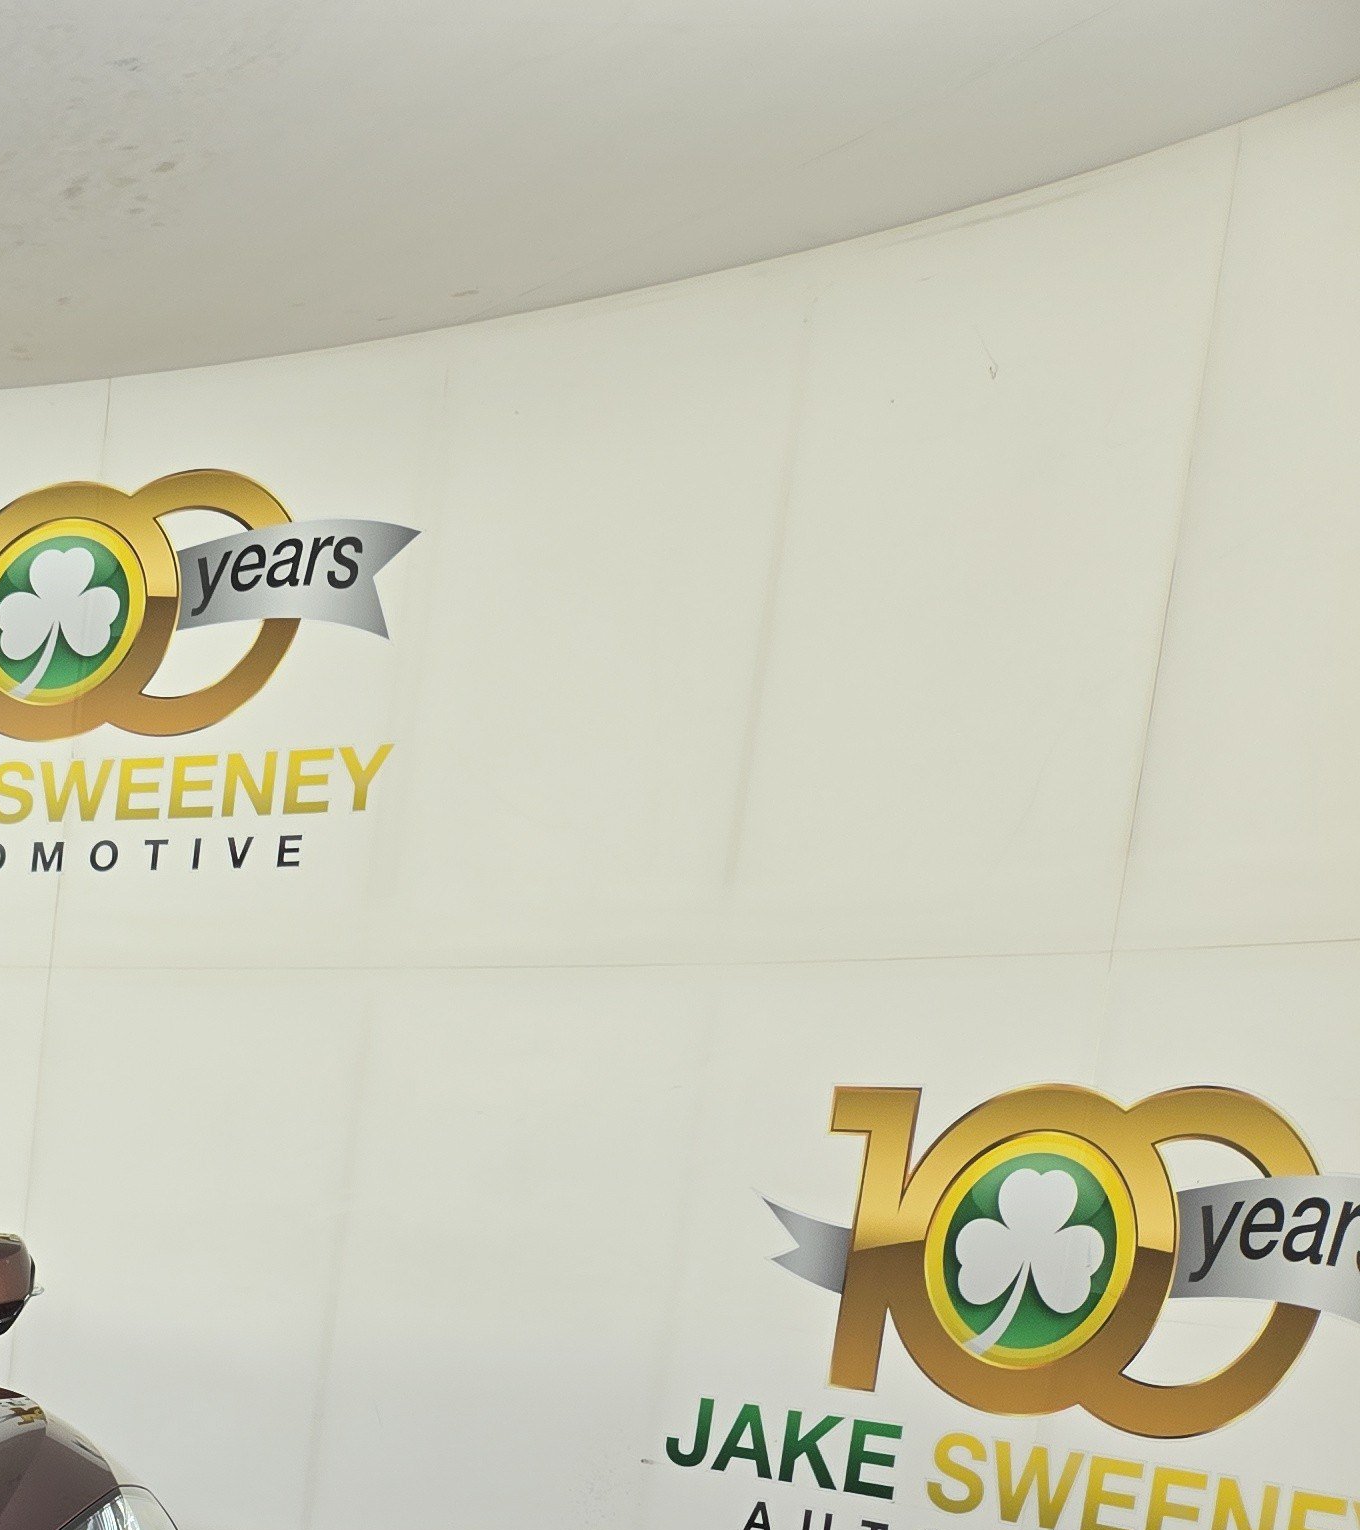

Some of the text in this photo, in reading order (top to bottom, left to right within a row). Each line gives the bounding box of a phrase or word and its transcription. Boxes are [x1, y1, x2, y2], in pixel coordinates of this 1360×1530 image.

[191, 535, 364, 618] years
[1189, 1193, 1360, 1284] year
[666, 1398, 903, 1500] JAKE
